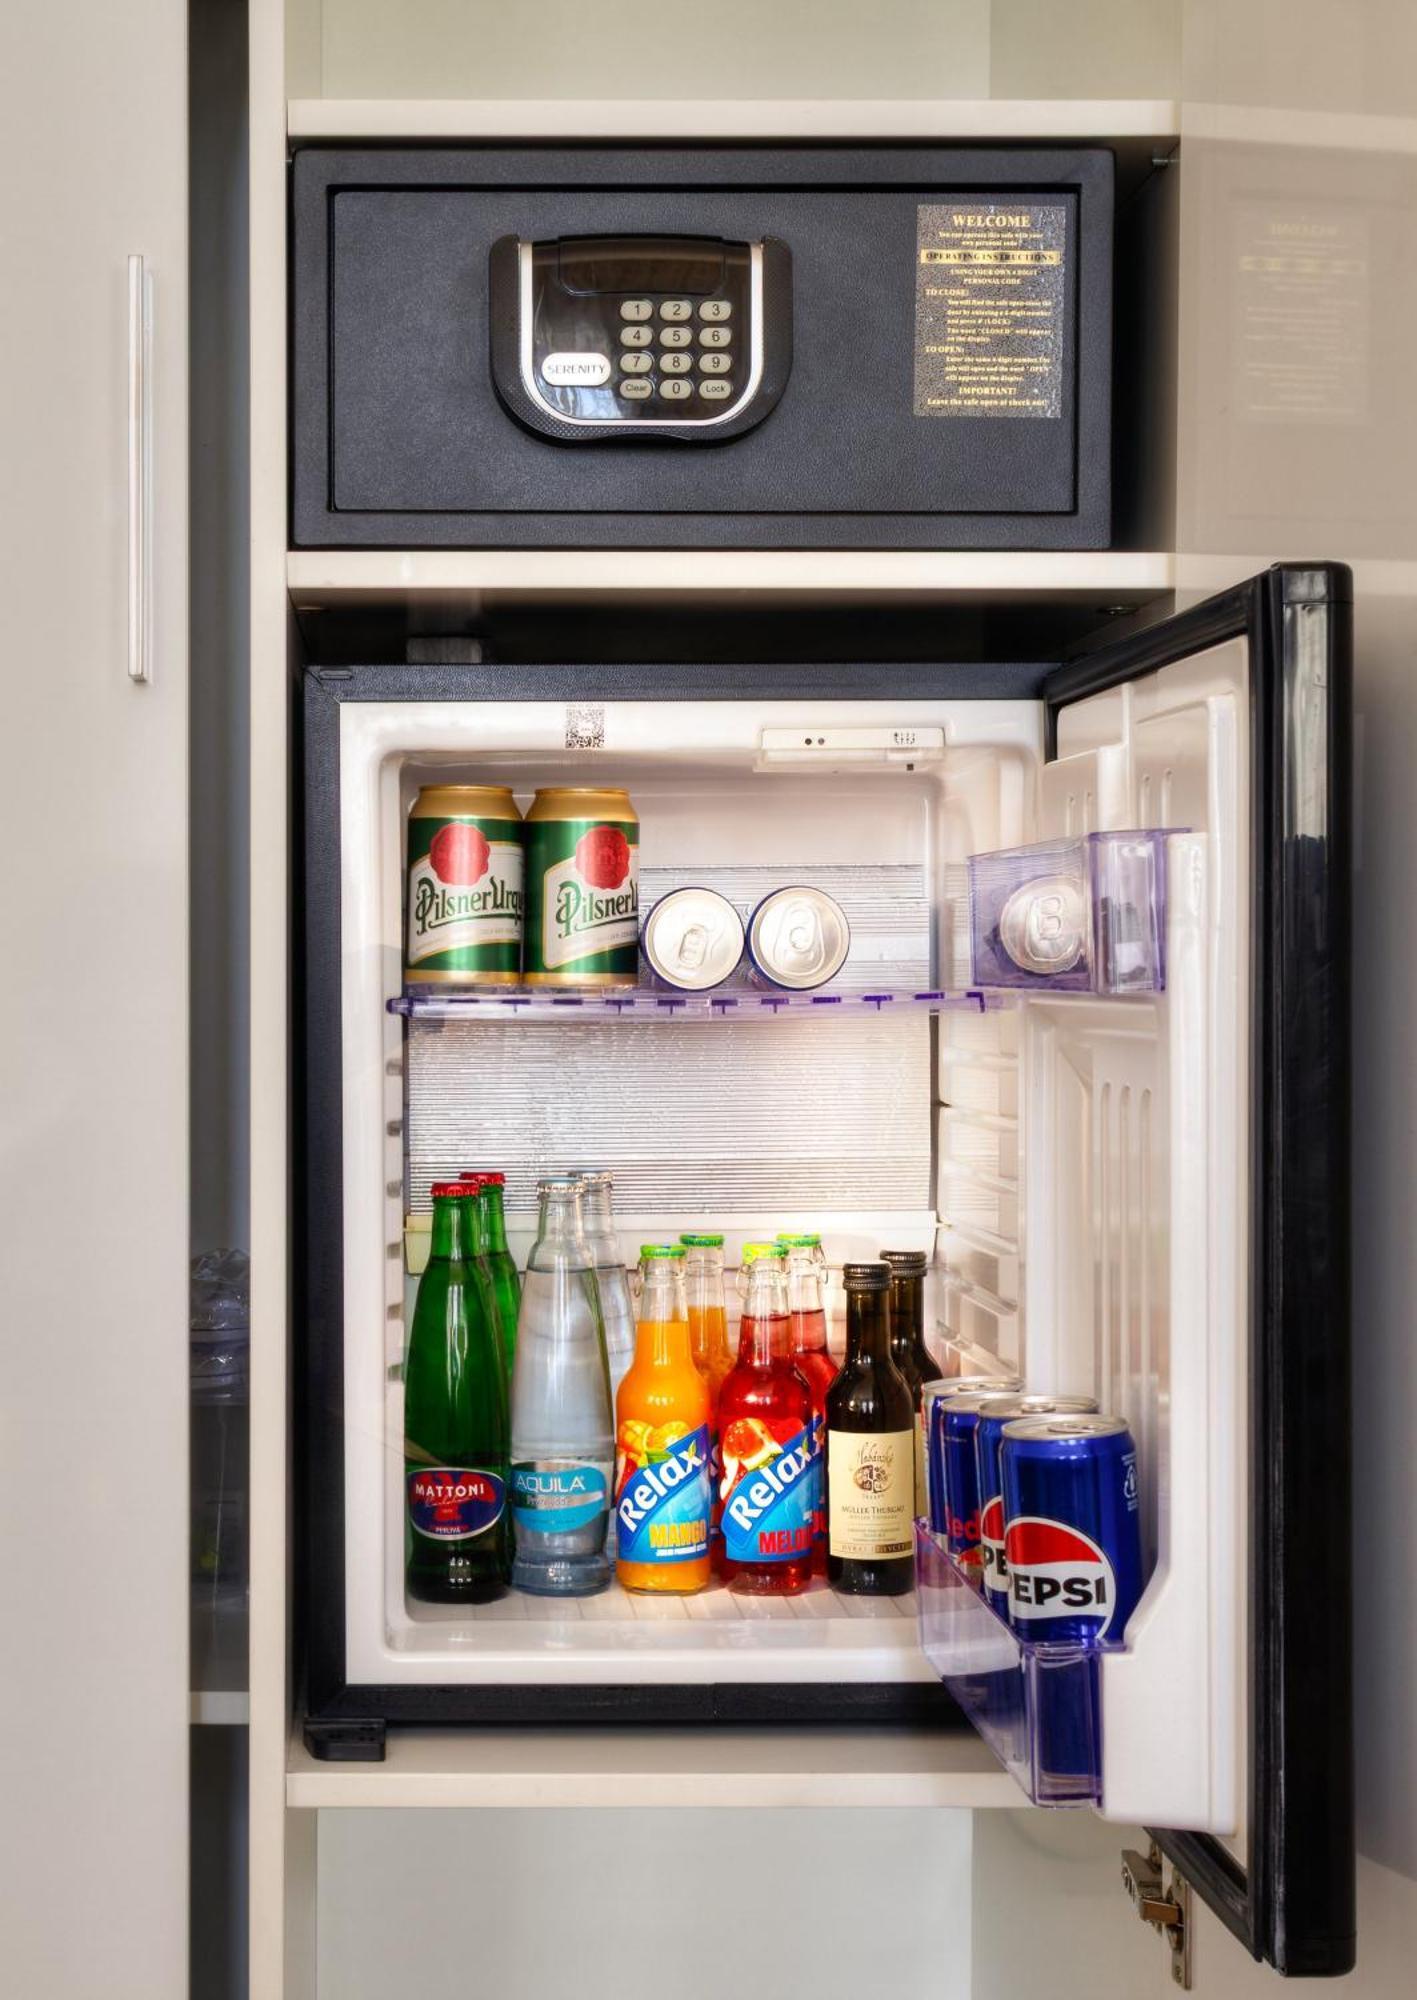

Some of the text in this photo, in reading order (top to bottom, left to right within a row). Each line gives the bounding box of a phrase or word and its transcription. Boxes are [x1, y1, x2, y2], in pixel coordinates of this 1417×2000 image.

[952, 215, 1031, 227] WELCOME
[926, 253, 1054, 261] OPERATING INSTRUCTIONS
[634, 304, 641, 315] 1
[672, 304, 681, 316] 2
[711, 304, 721, 316] 3
[632, 330, 641, 341] 4
[672, 330, 681, 342] 5
[711, 330, 721, 342] 6
[632, 356, 641, 367] 7
[672, 356, 681, 368] 8
[711, 356, 721, 368] 9
[547, 364, 605, 374] SERENITY
[625, 383, 647, 392] Clear
[672, 383, 681, 394] 0
[705, 383, 726, 393] Lock
[959, 386, 1017, 394] IMPORTANT!
[415, 876, 492, 936] Pilsner
[556, 880, 631, 939] Pilsner
[516, 1473, 586, 1493] AQUILA
[619, 1440, 703, 1533] Relax
[729, 1437, 812, 1532] Relax
[415, 1482, 485, 1497] MATTONI
[948, 1508, 982, 1540] ed
[649, 1519, 706, 1548] MANGO
[1012, 1572, 1107, 1608] EPSI
